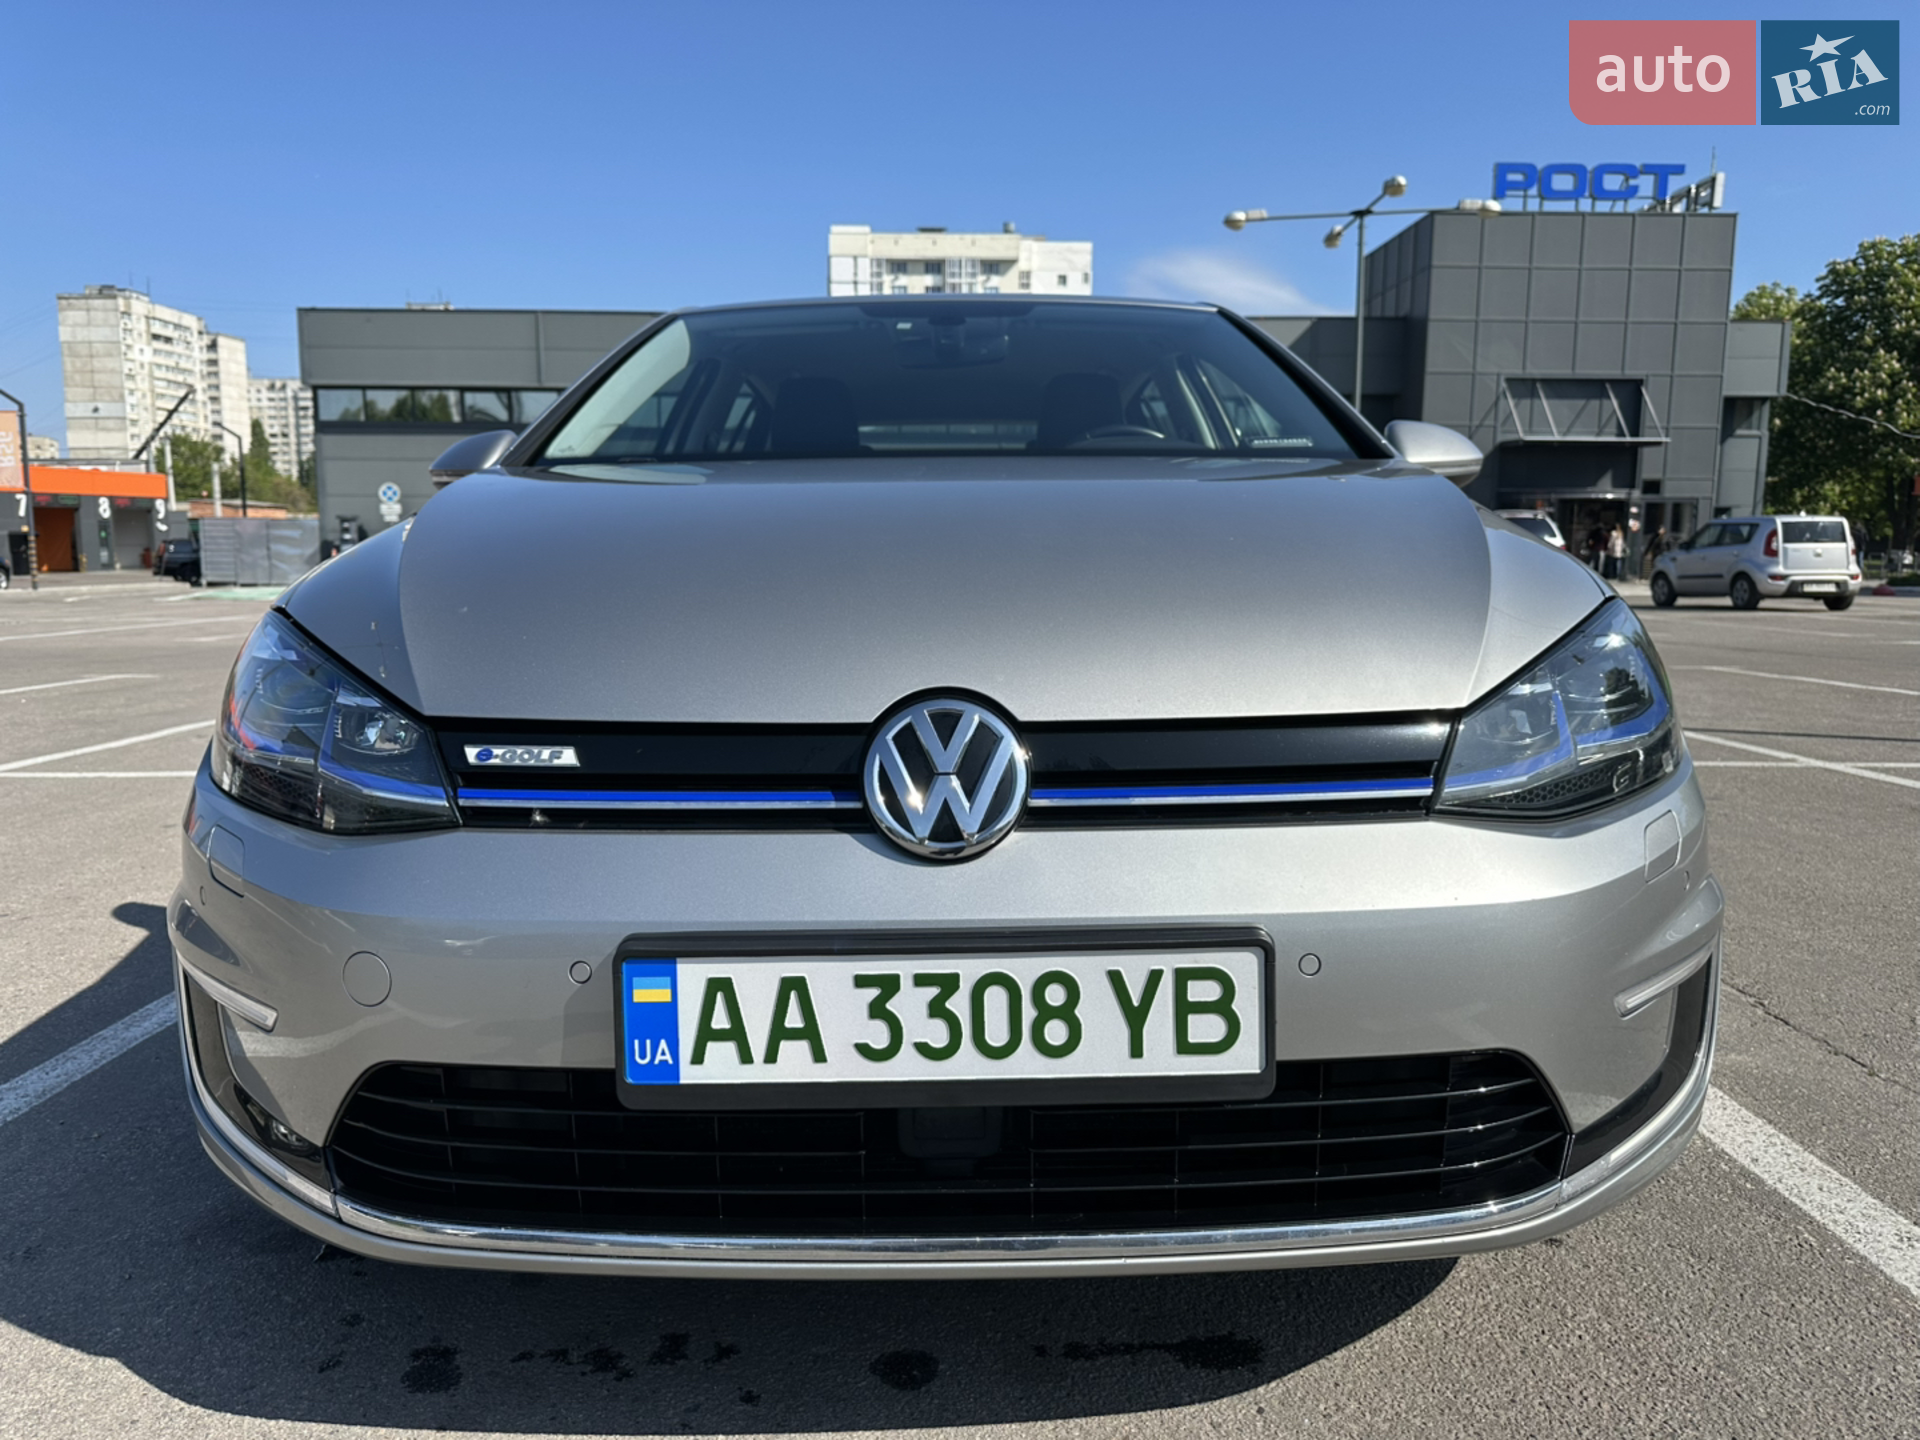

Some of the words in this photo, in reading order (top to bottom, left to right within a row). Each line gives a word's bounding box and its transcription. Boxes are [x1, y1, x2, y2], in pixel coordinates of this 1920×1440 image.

[1493, 163, 1685, 202] РОСТ
[15, 493, 27, 517] 7
[98, 496, 111, 518] 8
[689, 975, 827, 1066] AA
[851, 969, 1083, 1062] 3308
[1107, 965, 1242, 1060] YB
[633, 1038, 673, 1066] UA
